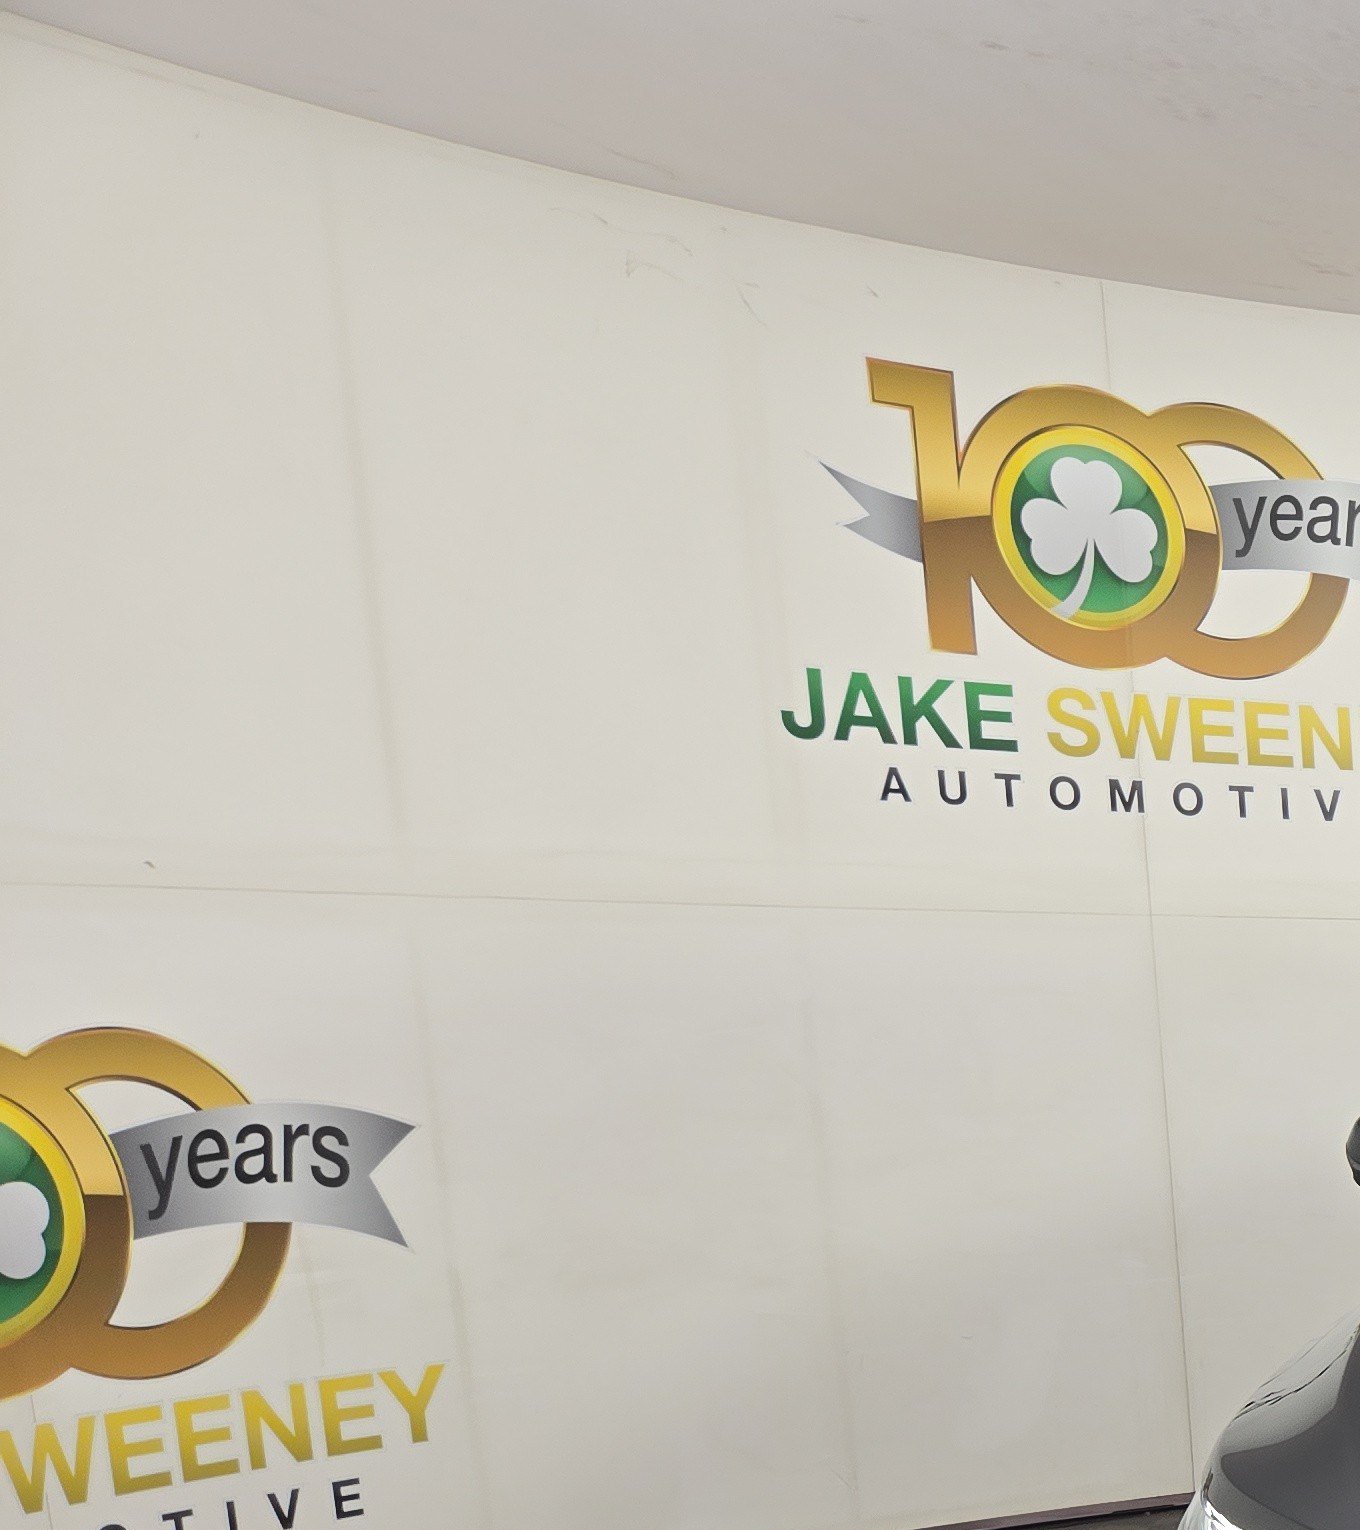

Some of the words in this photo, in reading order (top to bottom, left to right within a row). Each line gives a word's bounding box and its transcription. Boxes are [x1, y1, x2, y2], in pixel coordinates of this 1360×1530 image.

[779, 667, 1020, 754] JAKE
[139, 1122, 351, 1221] years
[0, 1363, 446, 1515] WEENEY
